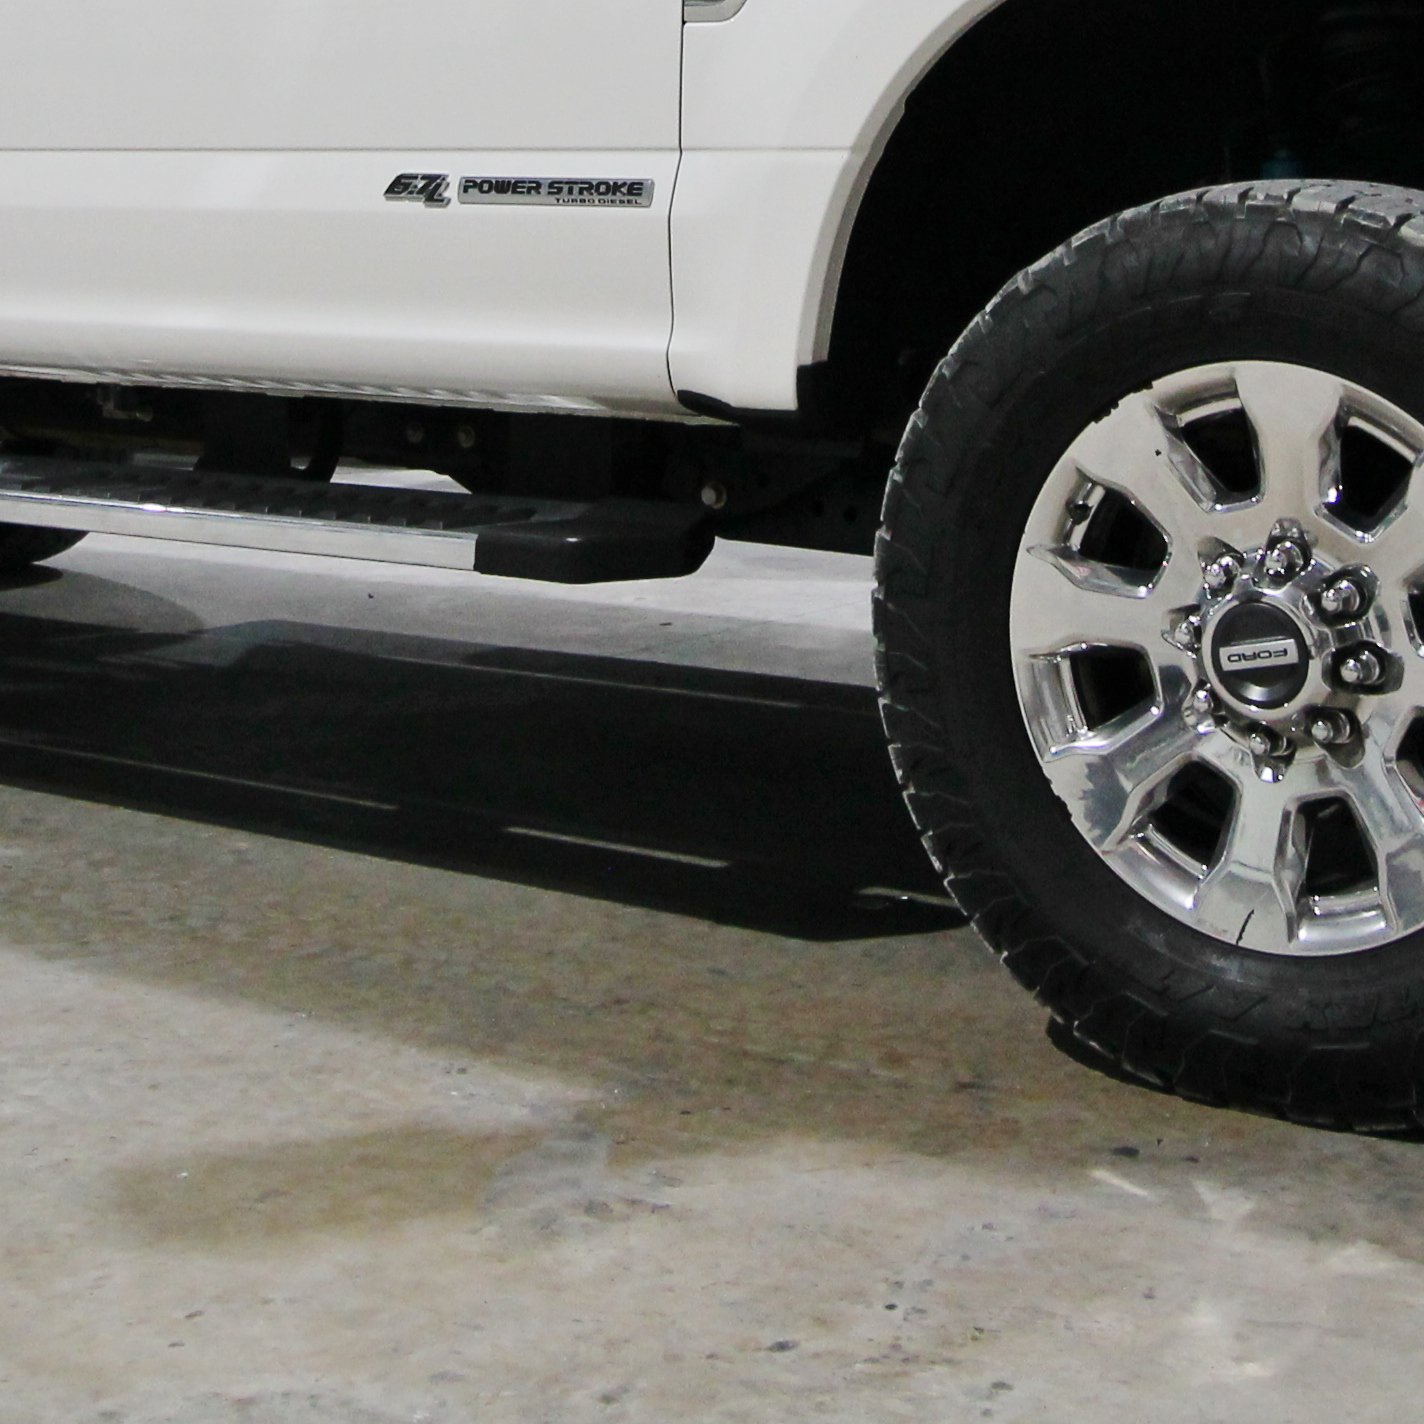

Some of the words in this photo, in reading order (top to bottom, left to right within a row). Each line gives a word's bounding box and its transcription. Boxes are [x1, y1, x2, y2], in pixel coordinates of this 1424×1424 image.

[383, 173, 451, 208] 6.7L
[463, 179, 542, 195] POWER
[547, 180, 644, 196] STROKE
[555, 197, 596, 205] TURBO
[1227, 647, 1288, 663] FORD
